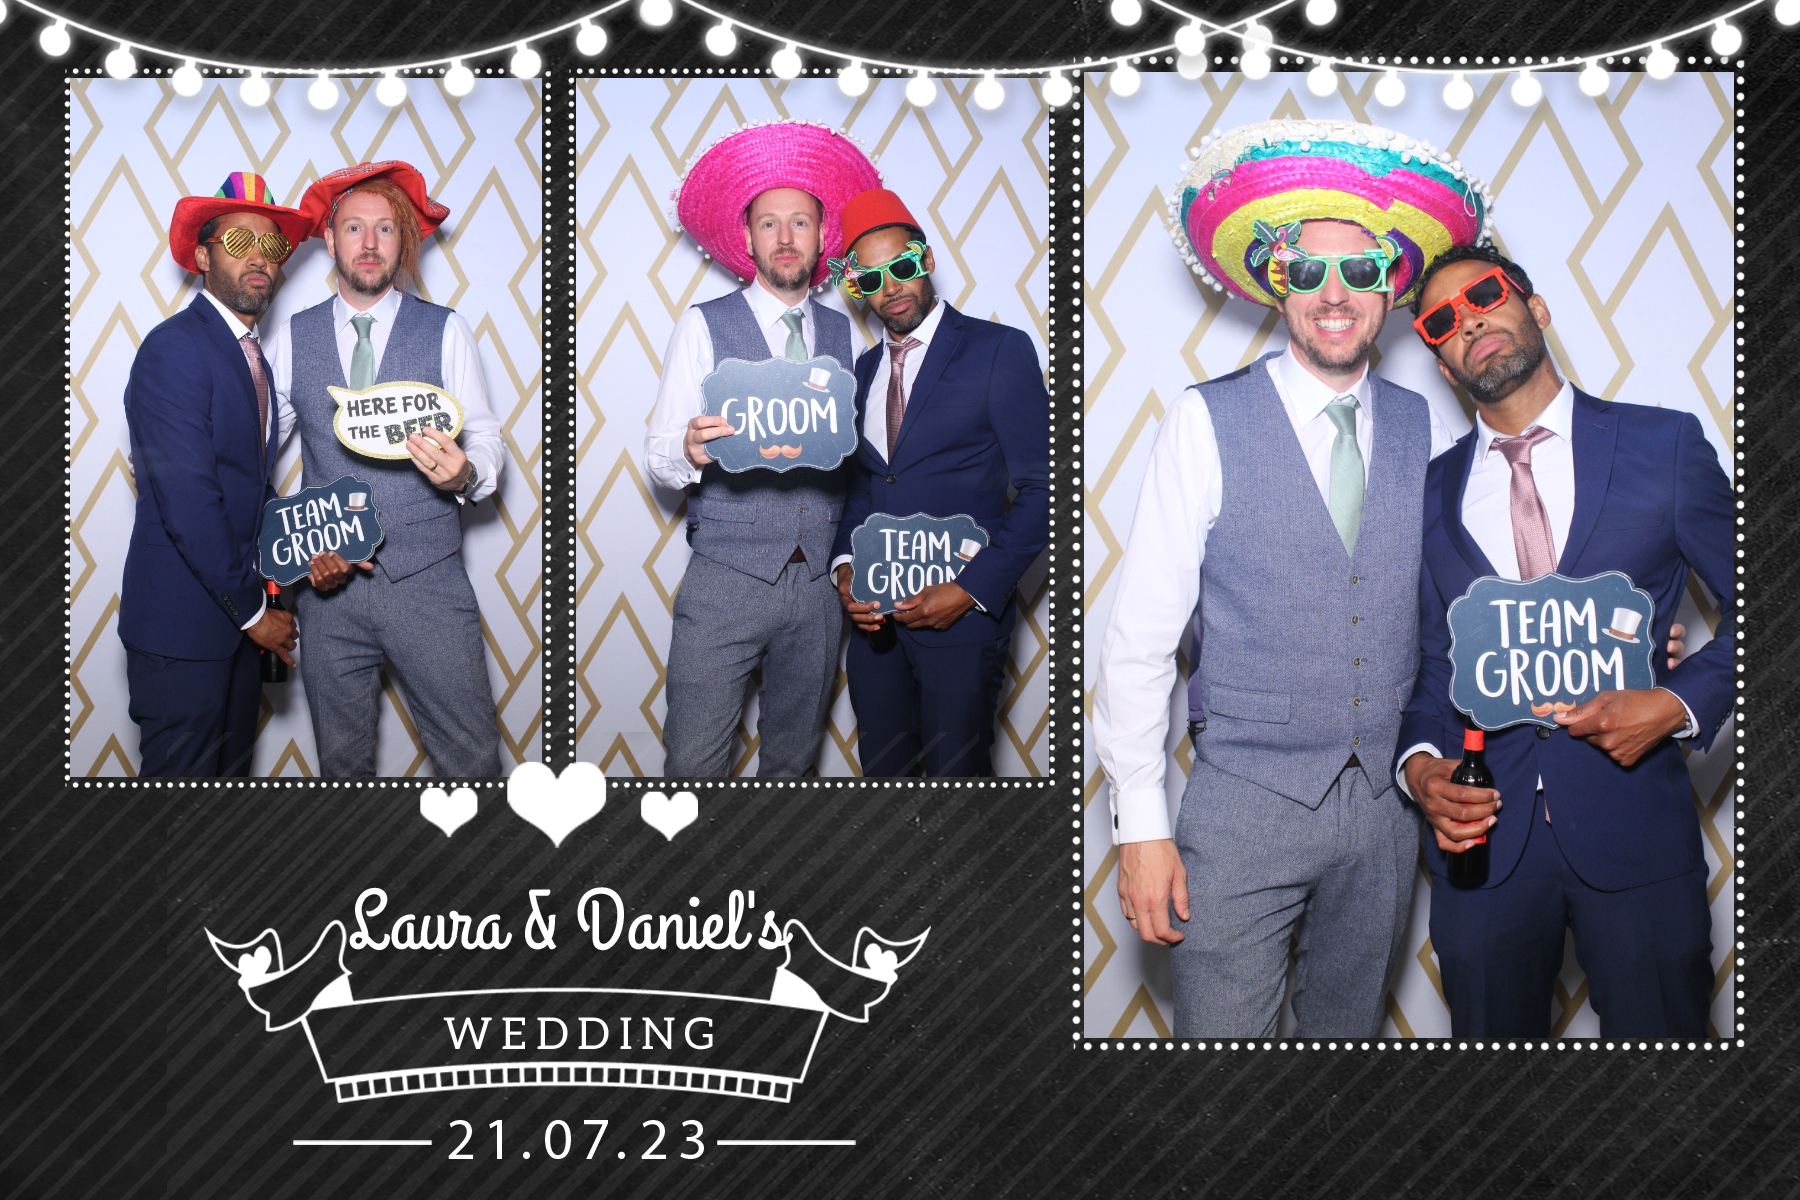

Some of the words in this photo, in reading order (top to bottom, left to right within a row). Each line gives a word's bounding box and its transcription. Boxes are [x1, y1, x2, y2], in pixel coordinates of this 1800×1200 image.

[347, 396, 398, 417] HERE
[402, 392, 441, 413] FOR
[721, 396, 838, 442] GROOM
[347, 425, 381, 440] THE
[384, 412, 454, 446] BEER
[275, 492, 343, 536] TEAM
[272, 515, 365, 567] GROOM
[879, 528, 951, 563] TEAM
[1489, 597, 1598, 649] TEAM
[1475, 647, 1625, 706] GROOM
